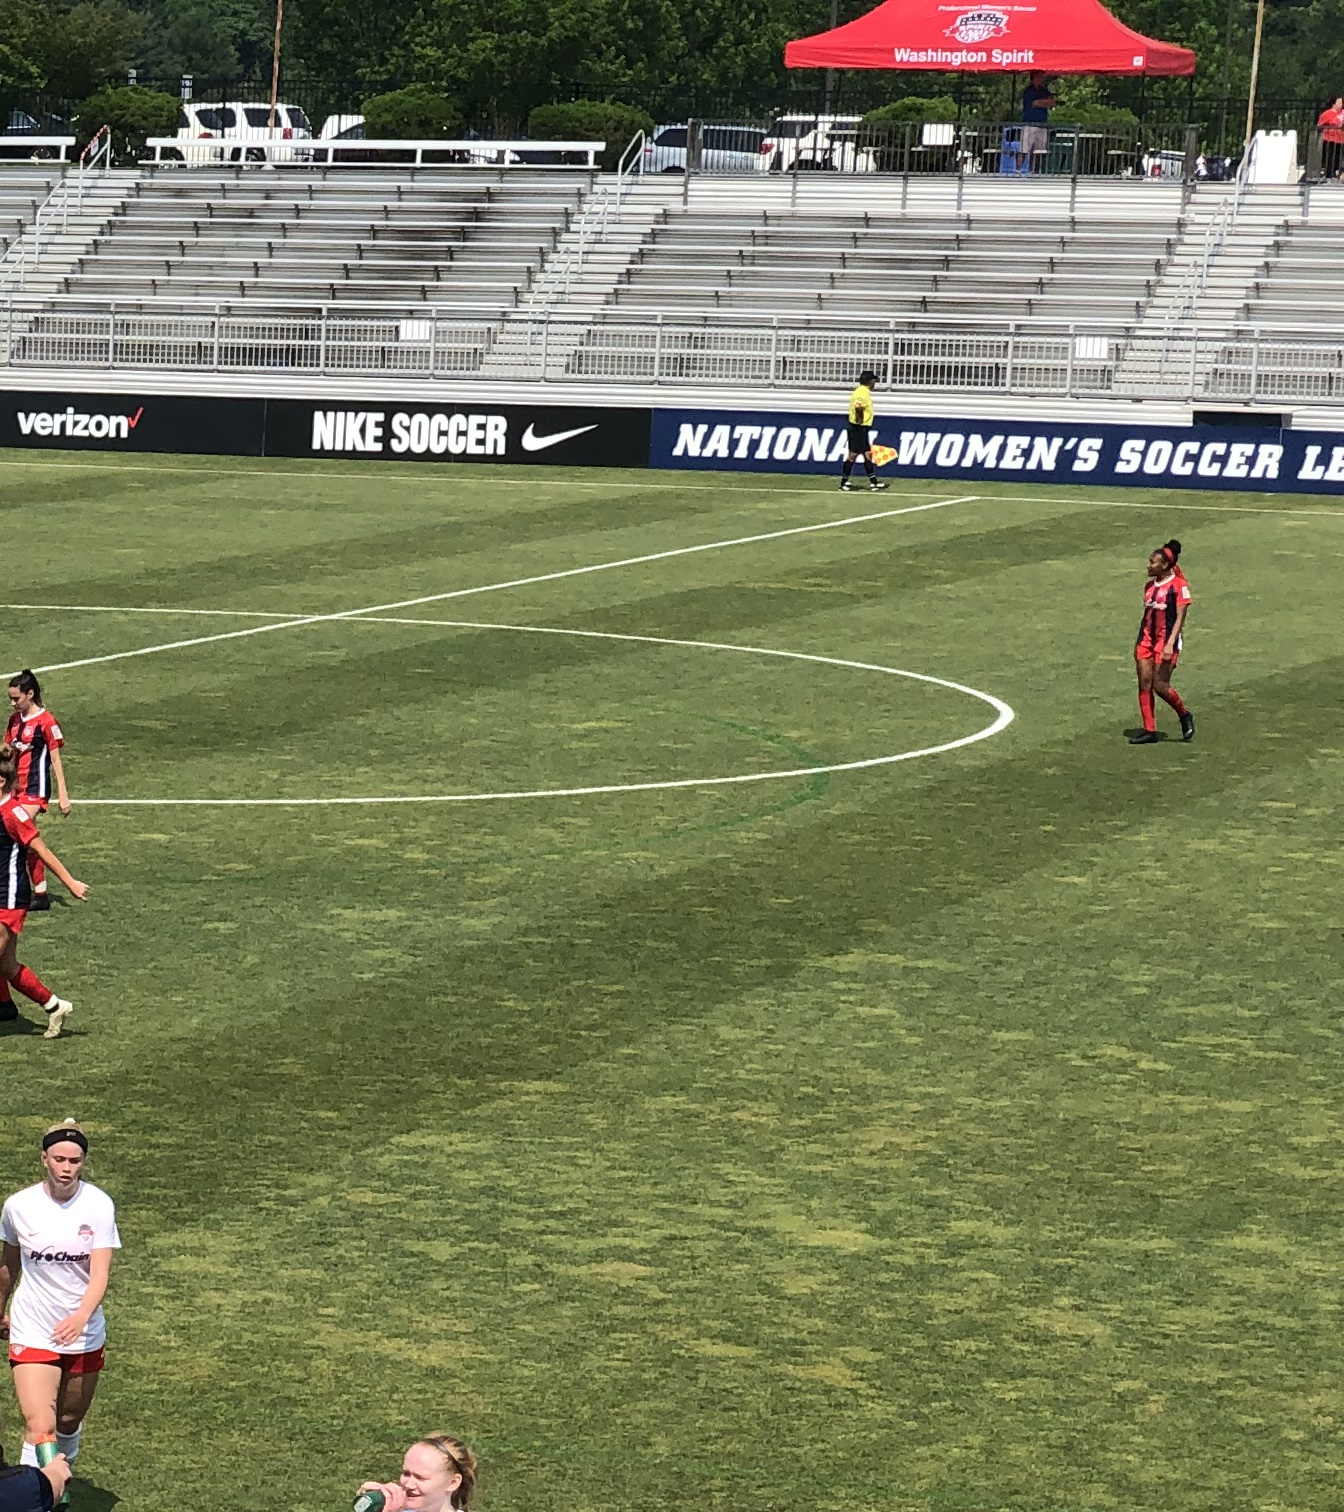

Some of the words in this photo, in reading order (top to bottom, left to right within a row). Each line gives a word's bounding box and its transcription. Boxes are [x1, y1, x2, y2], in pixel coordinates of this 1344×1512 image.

[894, 48, 987, 66] Washington
[992, 49, 1034, 66] Spirit
[17, 407, 129, 438] verizon
[312, 411, 385, 452] NIKE
[391, 412, 507, 455] SOCCER
[671, 423, 878, 464] NATIONA
[898, 431, 1103, 472] WOMEN'S
[1114, 439, 1284, 479] SOCCER
